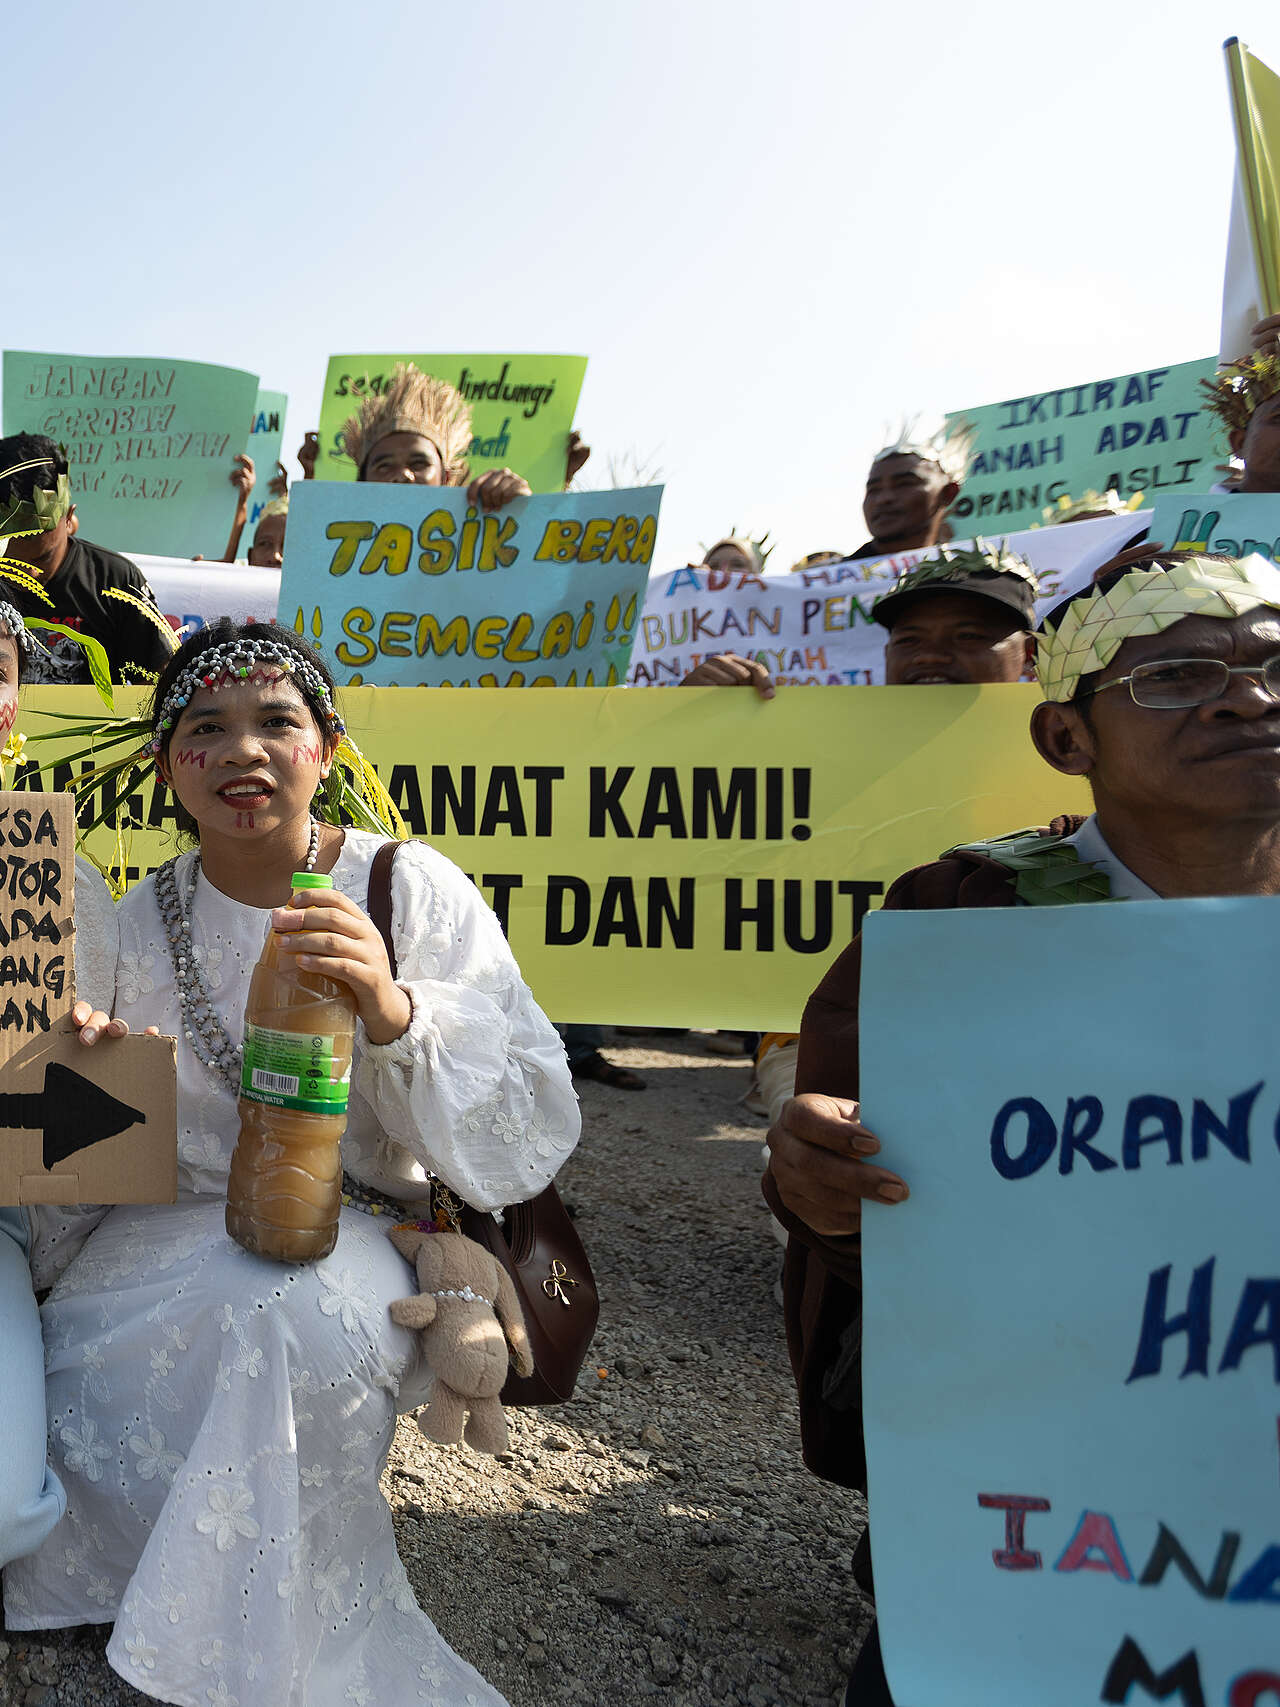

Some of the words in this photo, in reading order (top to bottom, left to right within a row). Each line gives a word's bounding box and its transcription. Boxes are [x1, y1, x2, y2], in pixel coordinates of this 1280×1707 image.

[24, 365, 176, 401] JANGAN
[457, 361, 557, 417] lindungi
[997, 369, 1169, 431] IKTIRAF
[966, 434, 1064, 477] ANAH
[1096, 411, 1200, 455] ADAT
[1103, 458, 1202, 493] ASLI
[533, 514, 658, 565] BERA
[642, 605, 781, 652] BUKAN
[335, 764, 565, 837] ANAT
[588, 766, 812, 840] KAMI!
[544, 874, 695, 949] DAN
[724, 878, 884, 954] HUT
[990, 1080, 1280, 1180] ORAN
